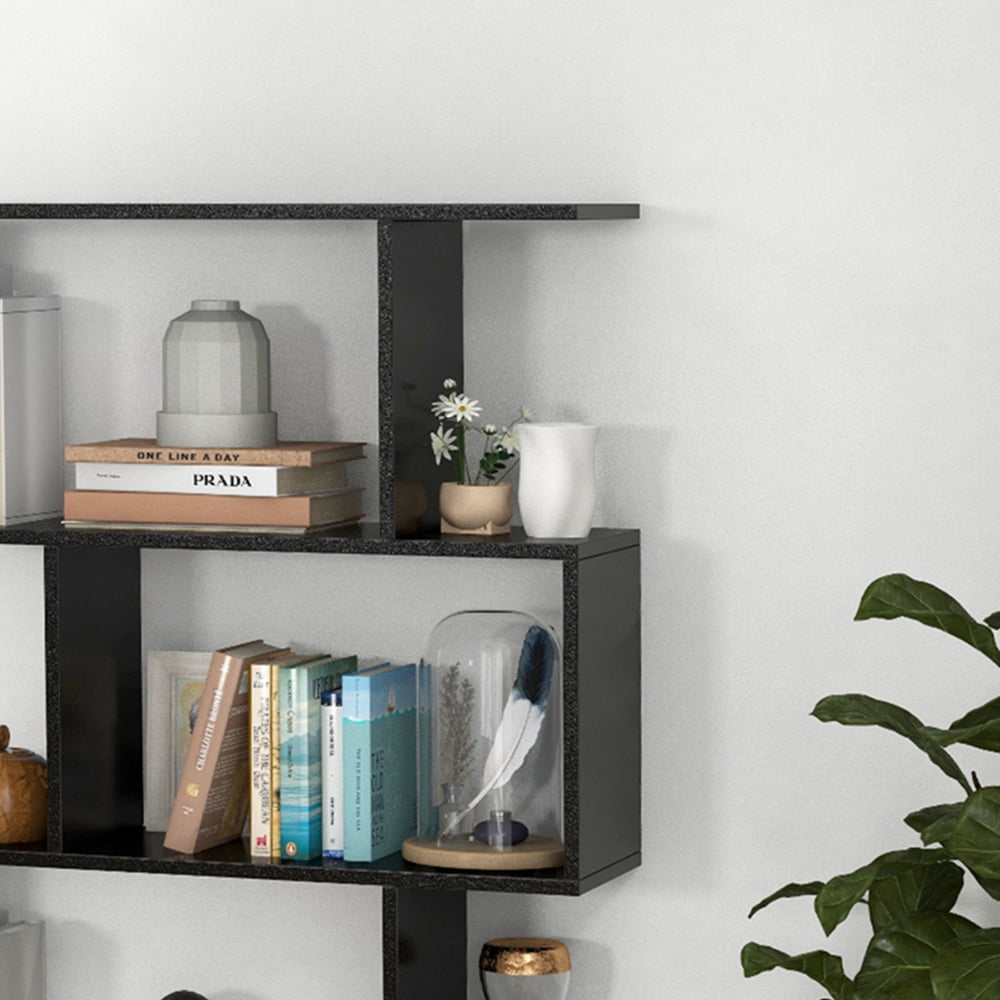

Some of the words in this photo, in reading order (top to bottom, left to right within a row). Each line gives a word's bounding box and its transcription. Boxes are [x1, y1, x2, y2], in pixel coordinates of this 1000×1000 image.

[137, 451, 163, 461] ONE
[168, 452, 197, 462] LINE
[202, 453, 211, 462] A
[214, 453, 240, 463] DAY
[193, 473, 252, 488] PRADA
[195, 721, 217, 772] CHARLOTTE
